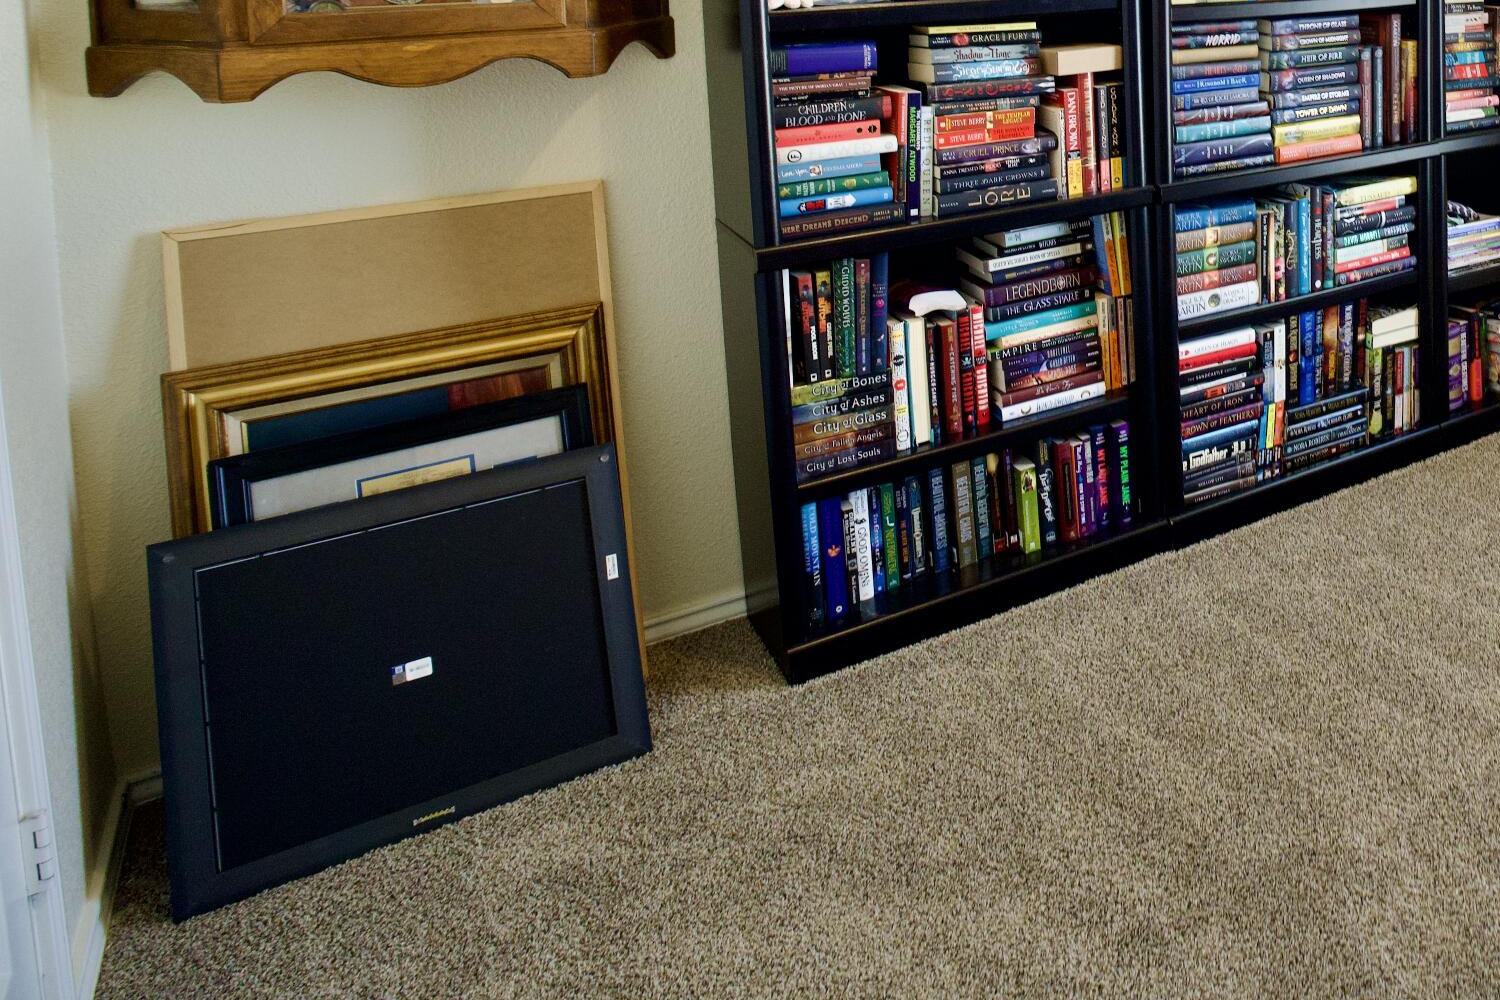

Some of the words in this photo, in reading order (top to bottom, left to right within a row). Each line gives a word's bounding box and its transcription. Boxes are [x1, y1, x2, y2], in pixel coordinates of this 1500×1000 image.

[1298, 22, 1322, 31] THRONE
[1322, 21, 1331, 29] OF
[1330, 20, 1347, 28] GLASS
[971, 33, 1001, 43] GRACE
[1008, 32, 1029, 41] FURY
[1205, 33, 1241, 47] HORRID
[1299, 37, 1318, 46] CROWN
[1301, 55, 1318, 63] HEIR
[1318, 53, 1327, 61] OF
[1328, 51, 1343, 60] FIRE
[1199, 79, 1226, 88] KINGDOM
[1230, 76, 1248, 85] BACK
[1297, 75, 1315, 84] QUEEN
[798, 101, 847, 115] CHILDREN
[1067, 91, 1077, 114] DAN
[1110, 87, 1118, 125] GOLDEN
[1295, 108, 1319, 119] TOWER
[1319, 106, 1328, 114] OF
[1328, 103, 1348, 114] DAWN
[785, 115, 823, 128] BLOOD
[837, 109, 866, 123] BONE
[909, 107, 917, 148] MARGARET
[951, 117, 968, 127] STEVE
[968, 116, 986, 126] BERRY
[1008, 111, 1031, 119] TEMPLAR
[1002, 116, 1023, 125] LEGACY
[1068, 113, 1079, 151] BROWN
[963, 147, 989, 159] CRUEL
[992, 143, 1020, 155] PRINCE
[909, 149, 917, 182] ATWOOD
[958, 166, 977, 174] DRESSED
[922, 158, 932, 206] QUEEN
[953, 181, 979, 189] THREE
[981, 177, 1003, 185] DARK
[1005, 171, 1038, 182] CROWNS
[968, 186, 1031, 207] LORE
[782, 223, 801, 234] HERE
[803, 220, 832, 232] DREAMS
[834, 214, 869, 226] DESCEND
[1176, 221, 1202, 232] ARTIN
[1312, 218, 1322, 260] HEARTLESS
[1343, 235, 1359, 247] DAVID
[1360, 231, 1381, 242] MORRELL
[1176, 261, 1203, 275] ARTIN
[840, 266, 850, 297] GILDED
[1005, 272, 1081, 302] LEGENDBORN
[842, 297, 851, 328] WOLVES
[1007, 308, 1020, 316] THE
[1023, 297, 1051, 313] GLASS
[1054, 290, 1079, 305] SPARE
[958, 316, 970, 353] MICHAEL
[972, 313, 985, 354] MICHAEL
[995, 342, 1038, 360] EMPIRE
[1194, 344, 1212, 353] QUEEN
[949, 351, 957, 384] CATCHING
[812, 386, 837, 396] City
[841, 380, 848, 391] of
[852, 374, 887, 388] Bones
[812, 404, 837, 416] City
[840, 400, 849, 410] of
[852, 394, 885, 408] Ashes
[1183, 405, 1208, 419] HEART
[1210, 402, 1220, 411] OF
[1224, 396, 1243, 408] IRON
[813, 421, 840, 434] City
[843, 418, 852, 428] of
[855, 410, 887, 425] Glass
[1187, 421, 1209, 435] ROWN
[1219, 409, 1254, 426] FEATHERS
[804, 444, 822, 454] City
[856, 431, 883, 442] Angels
[1120, 445, 1129, 458] MY
[1293, 441, 1308, 452] NORA
[1308, 434, 1330, 448] ROBERTS
[806, 460, 826, 472] City
[828, 457, 834, 467] of
[837, 454, 856, 465] Lost
[857, 447, 881, 460] Souls
[1098, 449, 1106, 461] MY
[1189, 445, 1228, 470] Godfather
[974, 464, 987, 500] BEAUTIFUL
[1099, 462, 1108, 484] LADY
[1121, 459, 1130, 484] PLAIN
[1198, 478, 1215, 487] HOLLOW
[932, 475, 944, 513] BEAUTIFUL
[957, 475, 970, 516] BEAUTIFUL
[1100, 485, 1108, 505] JANE
[1121, 485, 1131, 505] JANE
[1194, 494, 1211, 502] LIBRARY
[809, 506, 819, 534] COLD
[959, 517, 972, 543] CHAOS
[977, 500, 990, 539] REDEMPTION
[858, 527, 868, 555] GOOD
[934, 513, 947, 550] DARKNESS
[811, 535, 821, 587] MOUNTAIN
[860, 555, 870, 588] OMENS
